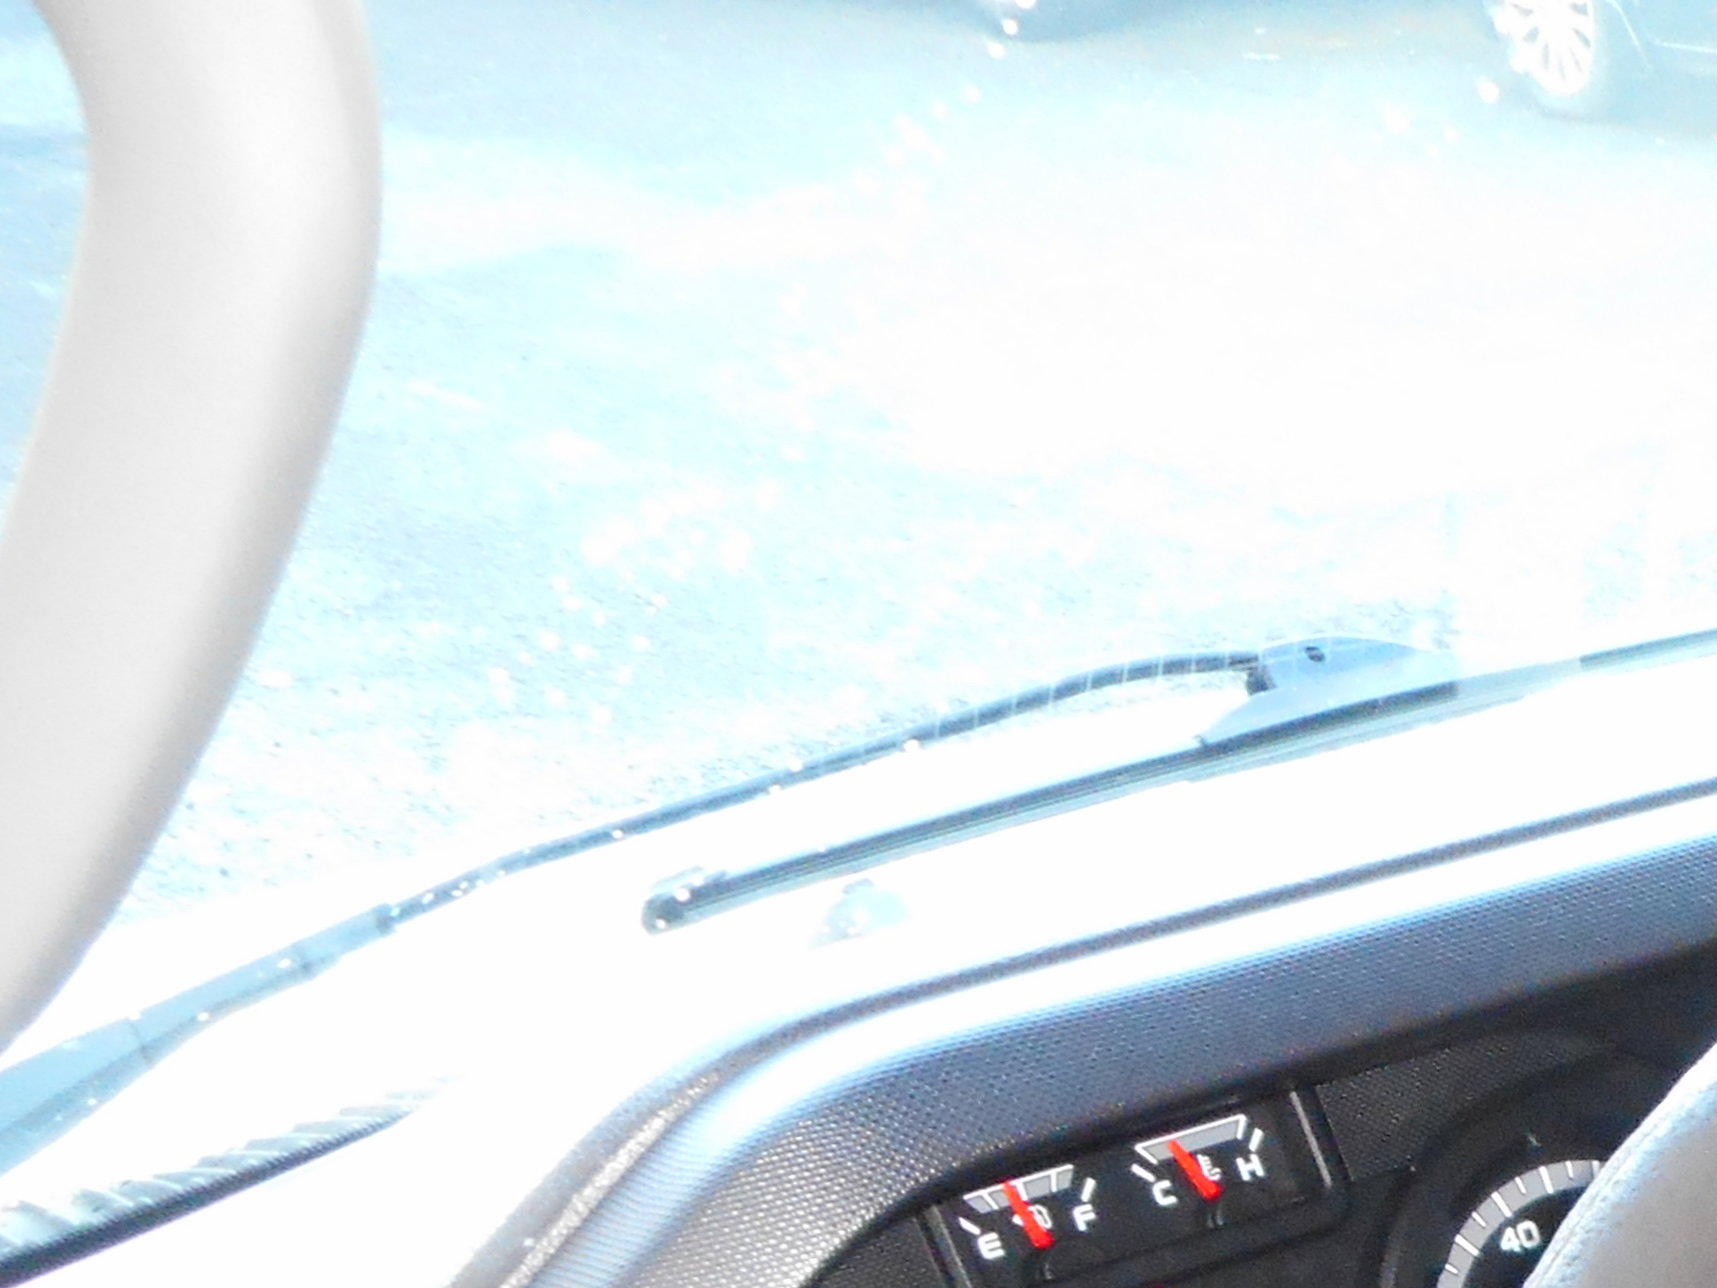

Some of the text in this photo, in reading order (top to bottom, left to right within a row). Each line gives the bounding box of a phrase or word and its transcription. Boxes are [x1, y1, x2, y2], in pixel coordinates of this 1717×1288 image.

[1236, 1153, 1266, 1182] H
[1152, 1179, 1178, 1206] C
[1073, 1203, 1097, 1232] F
[977, 1232, 1005, 1260] E
[1500, 1220, 1541, 1252] 40
